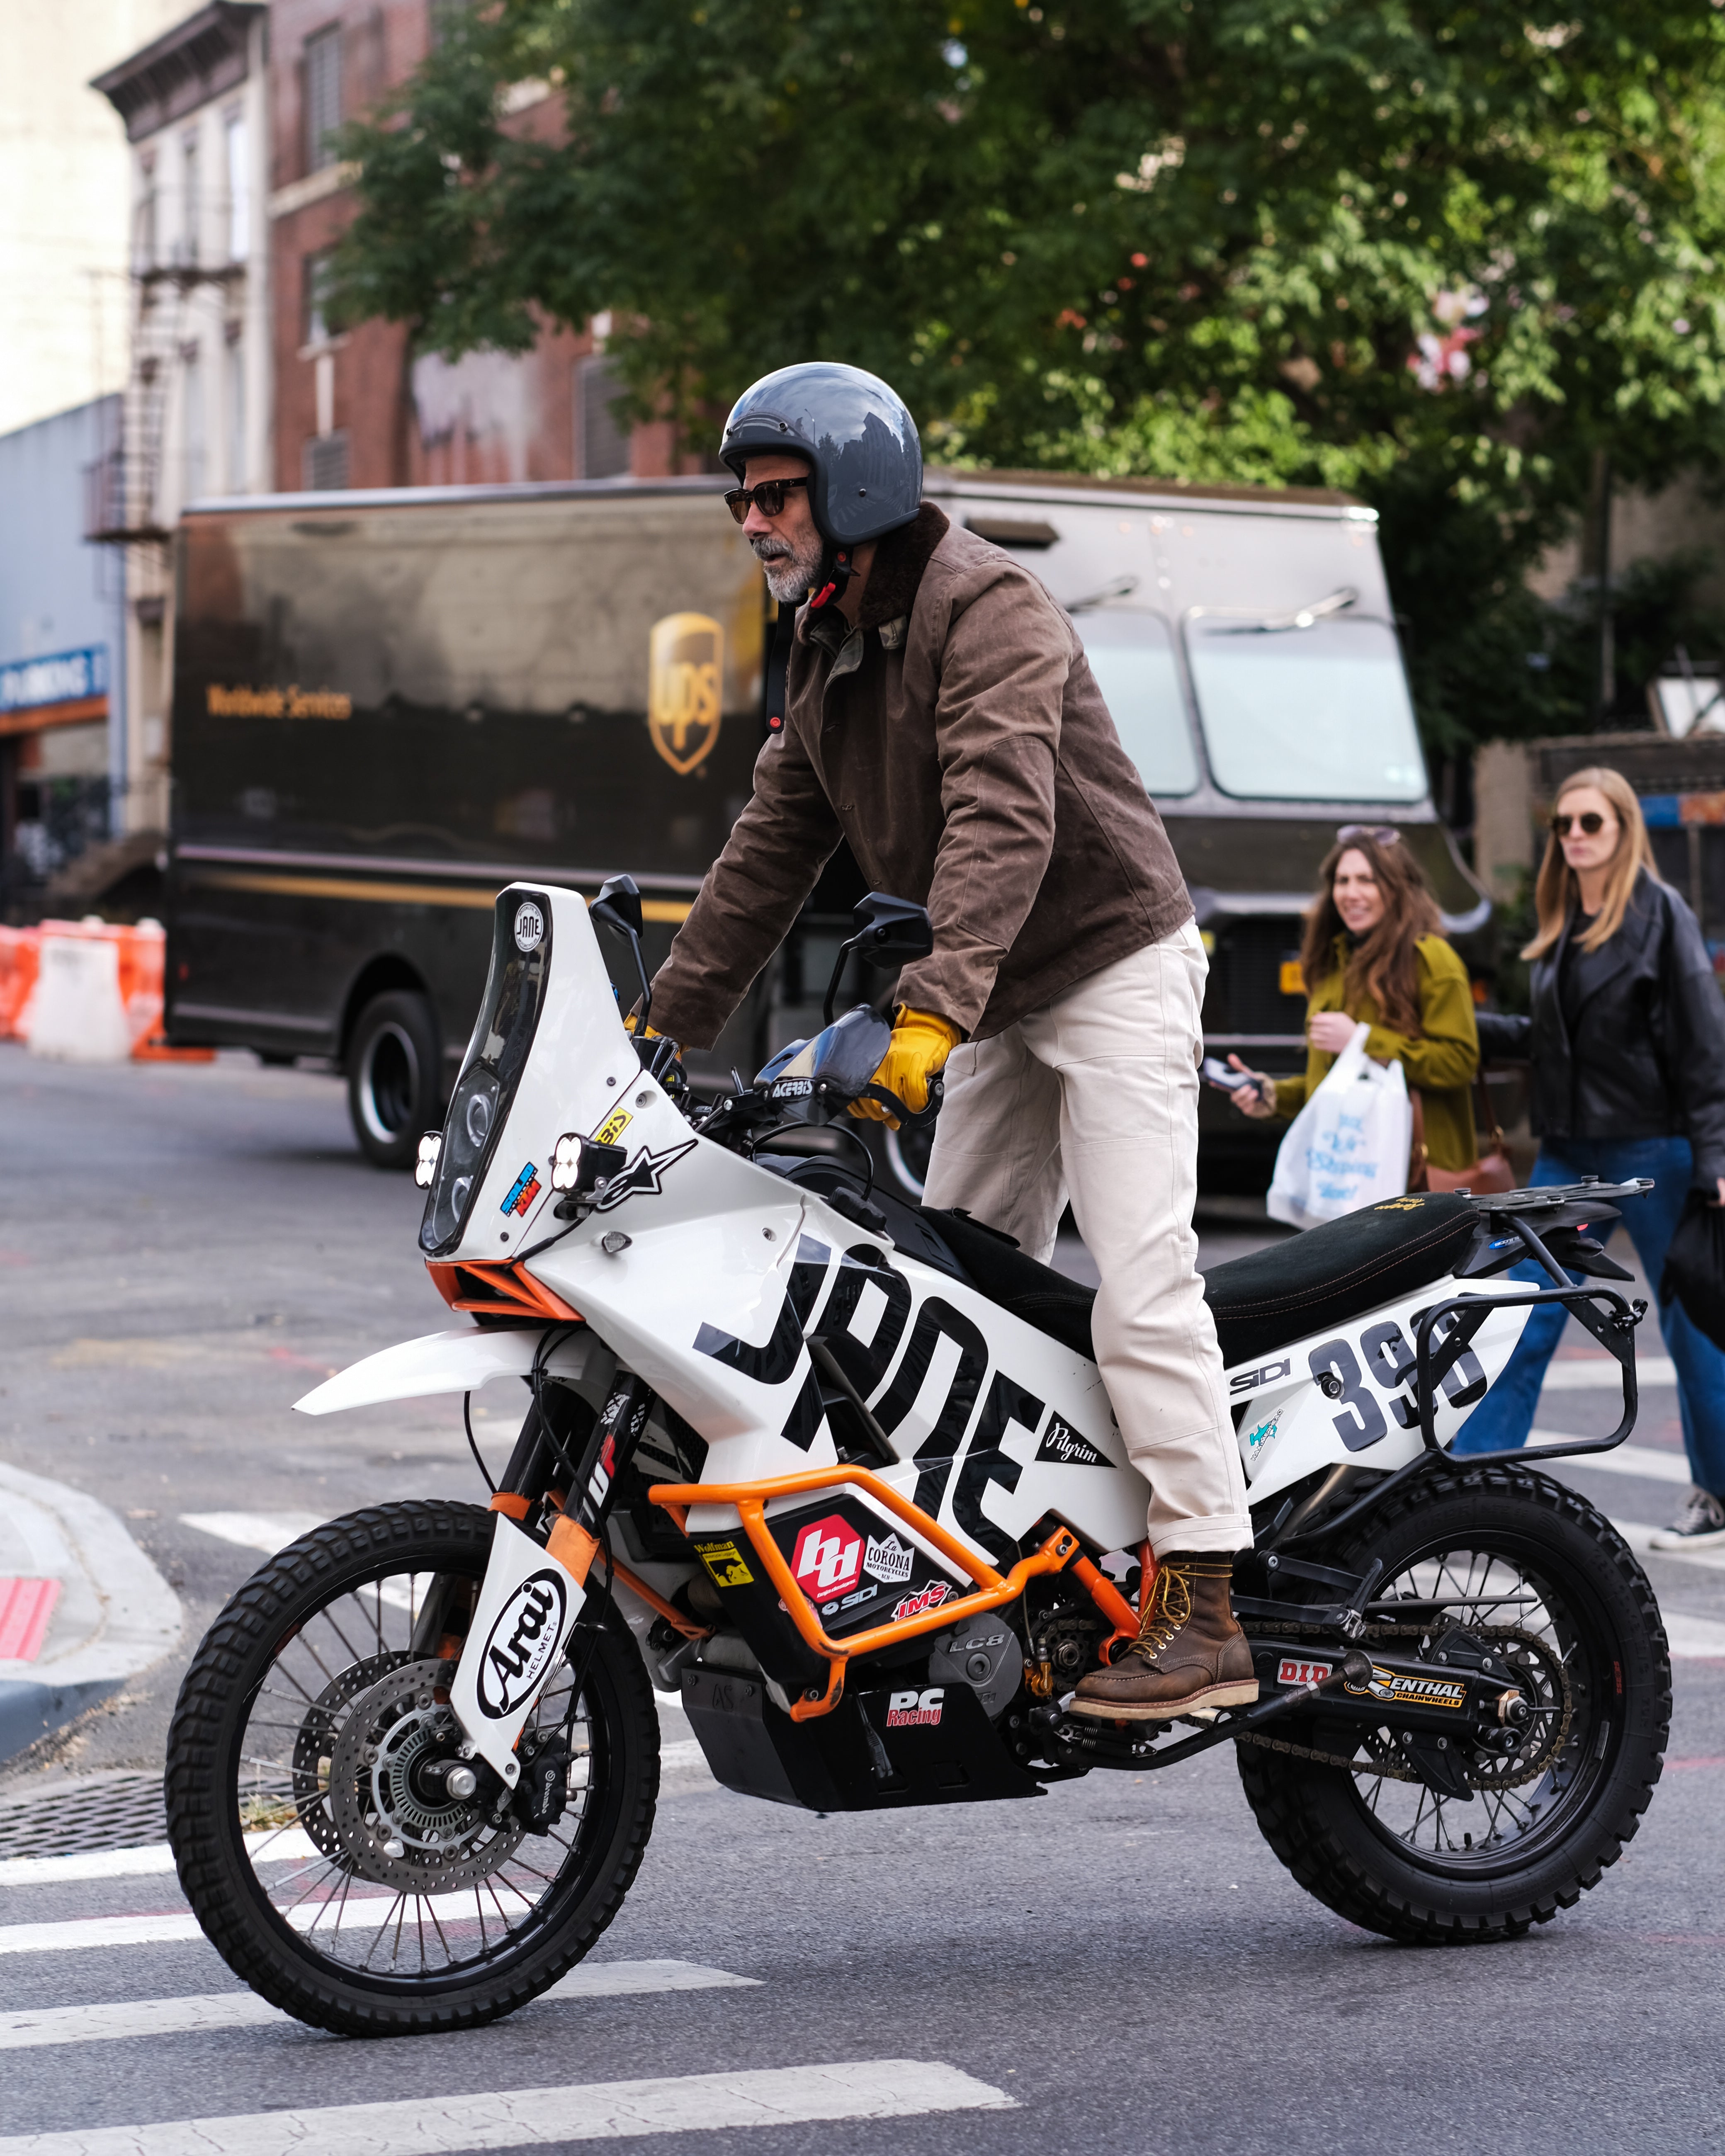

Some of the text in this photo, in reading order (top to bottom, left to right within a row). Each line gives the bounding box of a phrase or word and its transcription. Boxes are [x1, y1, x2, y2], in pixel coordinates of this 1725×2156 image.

[288, 684, 351, 721] Services
[516, 916, 540, 937] JANE
[1229, 1358, 1291, 1396] SIDI
[1046, 1423, 1097, 1463] Pilgrim
[1251, 1409, 1284, 1462] HAMMERHEAD
[693, 1541, 735, 1553] Wolfman
[797, 1529, 861, 1588] bd
[868, 1547, 910, 1571] CORONA
[866, 1562, 909, 1578] MOTORCYCLES
[841, 1584, 878, 1611] SIDI
[897, 1584, 946, 1620] IMS
[489, 1583, 554, 1714] Arai
[526, 1624, 554, 1679] HELMET
[949, 1634, 1005, 1653] LC8
[889, 1687, 945, 1712] PC
[1396, 1692, 1460, 1706] CHAINWHEELS
[886, 1707, 942, 1727] Racing
